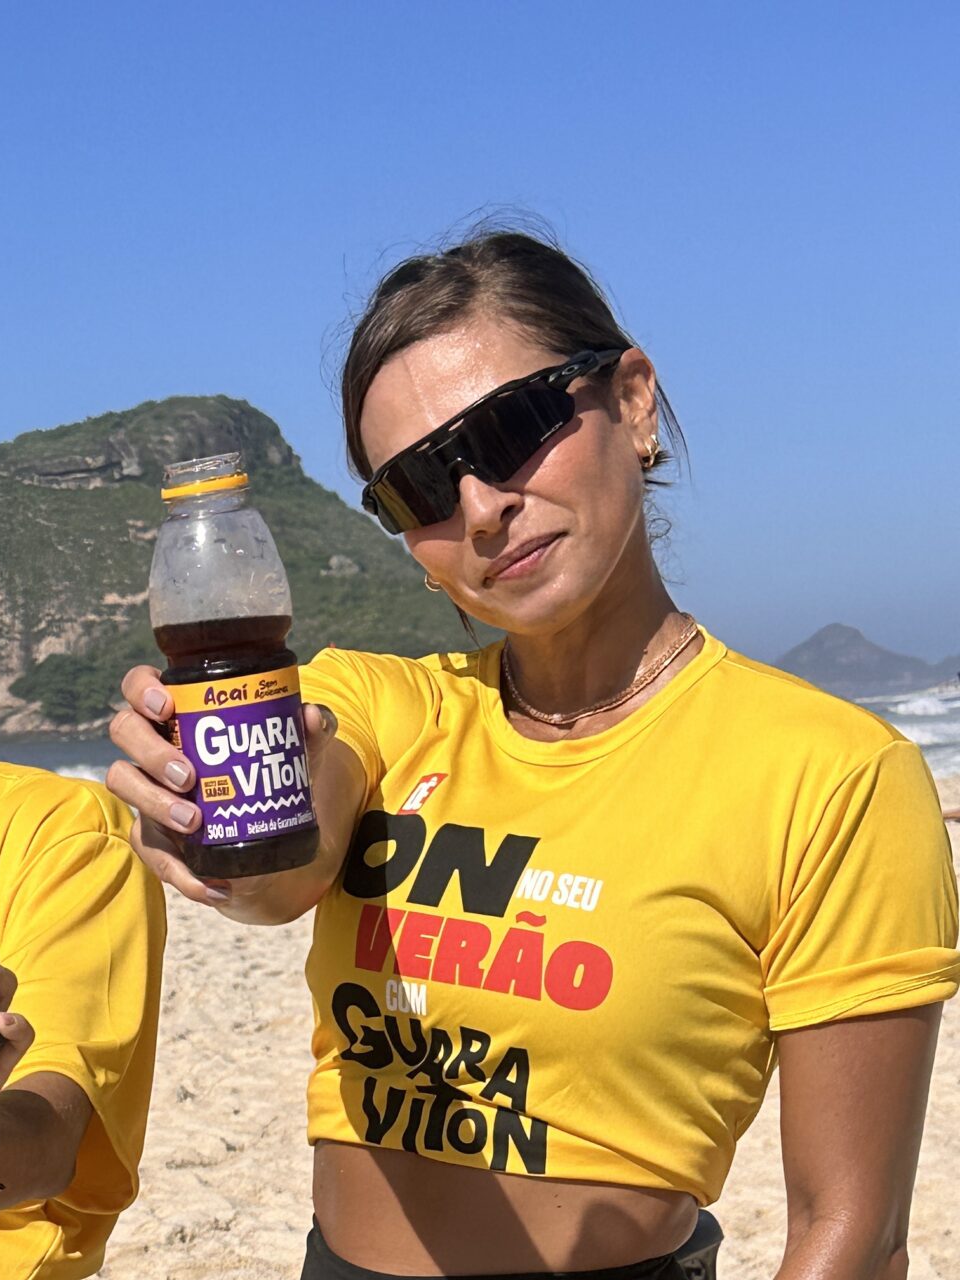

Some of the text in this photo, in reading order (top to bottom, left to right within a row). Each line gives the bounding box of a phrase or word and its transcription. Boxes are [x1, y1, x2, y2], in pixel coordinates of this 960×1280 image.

[204, 683, 248, 706] Açaí
[194, 715, 300, 766] GUARA
[402, 775, 438, 810] DÊ
[207, 821, 238, 840] 500 ml
[343, 810, 604, 918] ON NO SEU
[355, 904, 614, 1011] VERÃO
[386, 980, 427, 1017] COM
[331, 981, 530, 1114] GUARA
[361, 1076, 548, 1175] VITON
